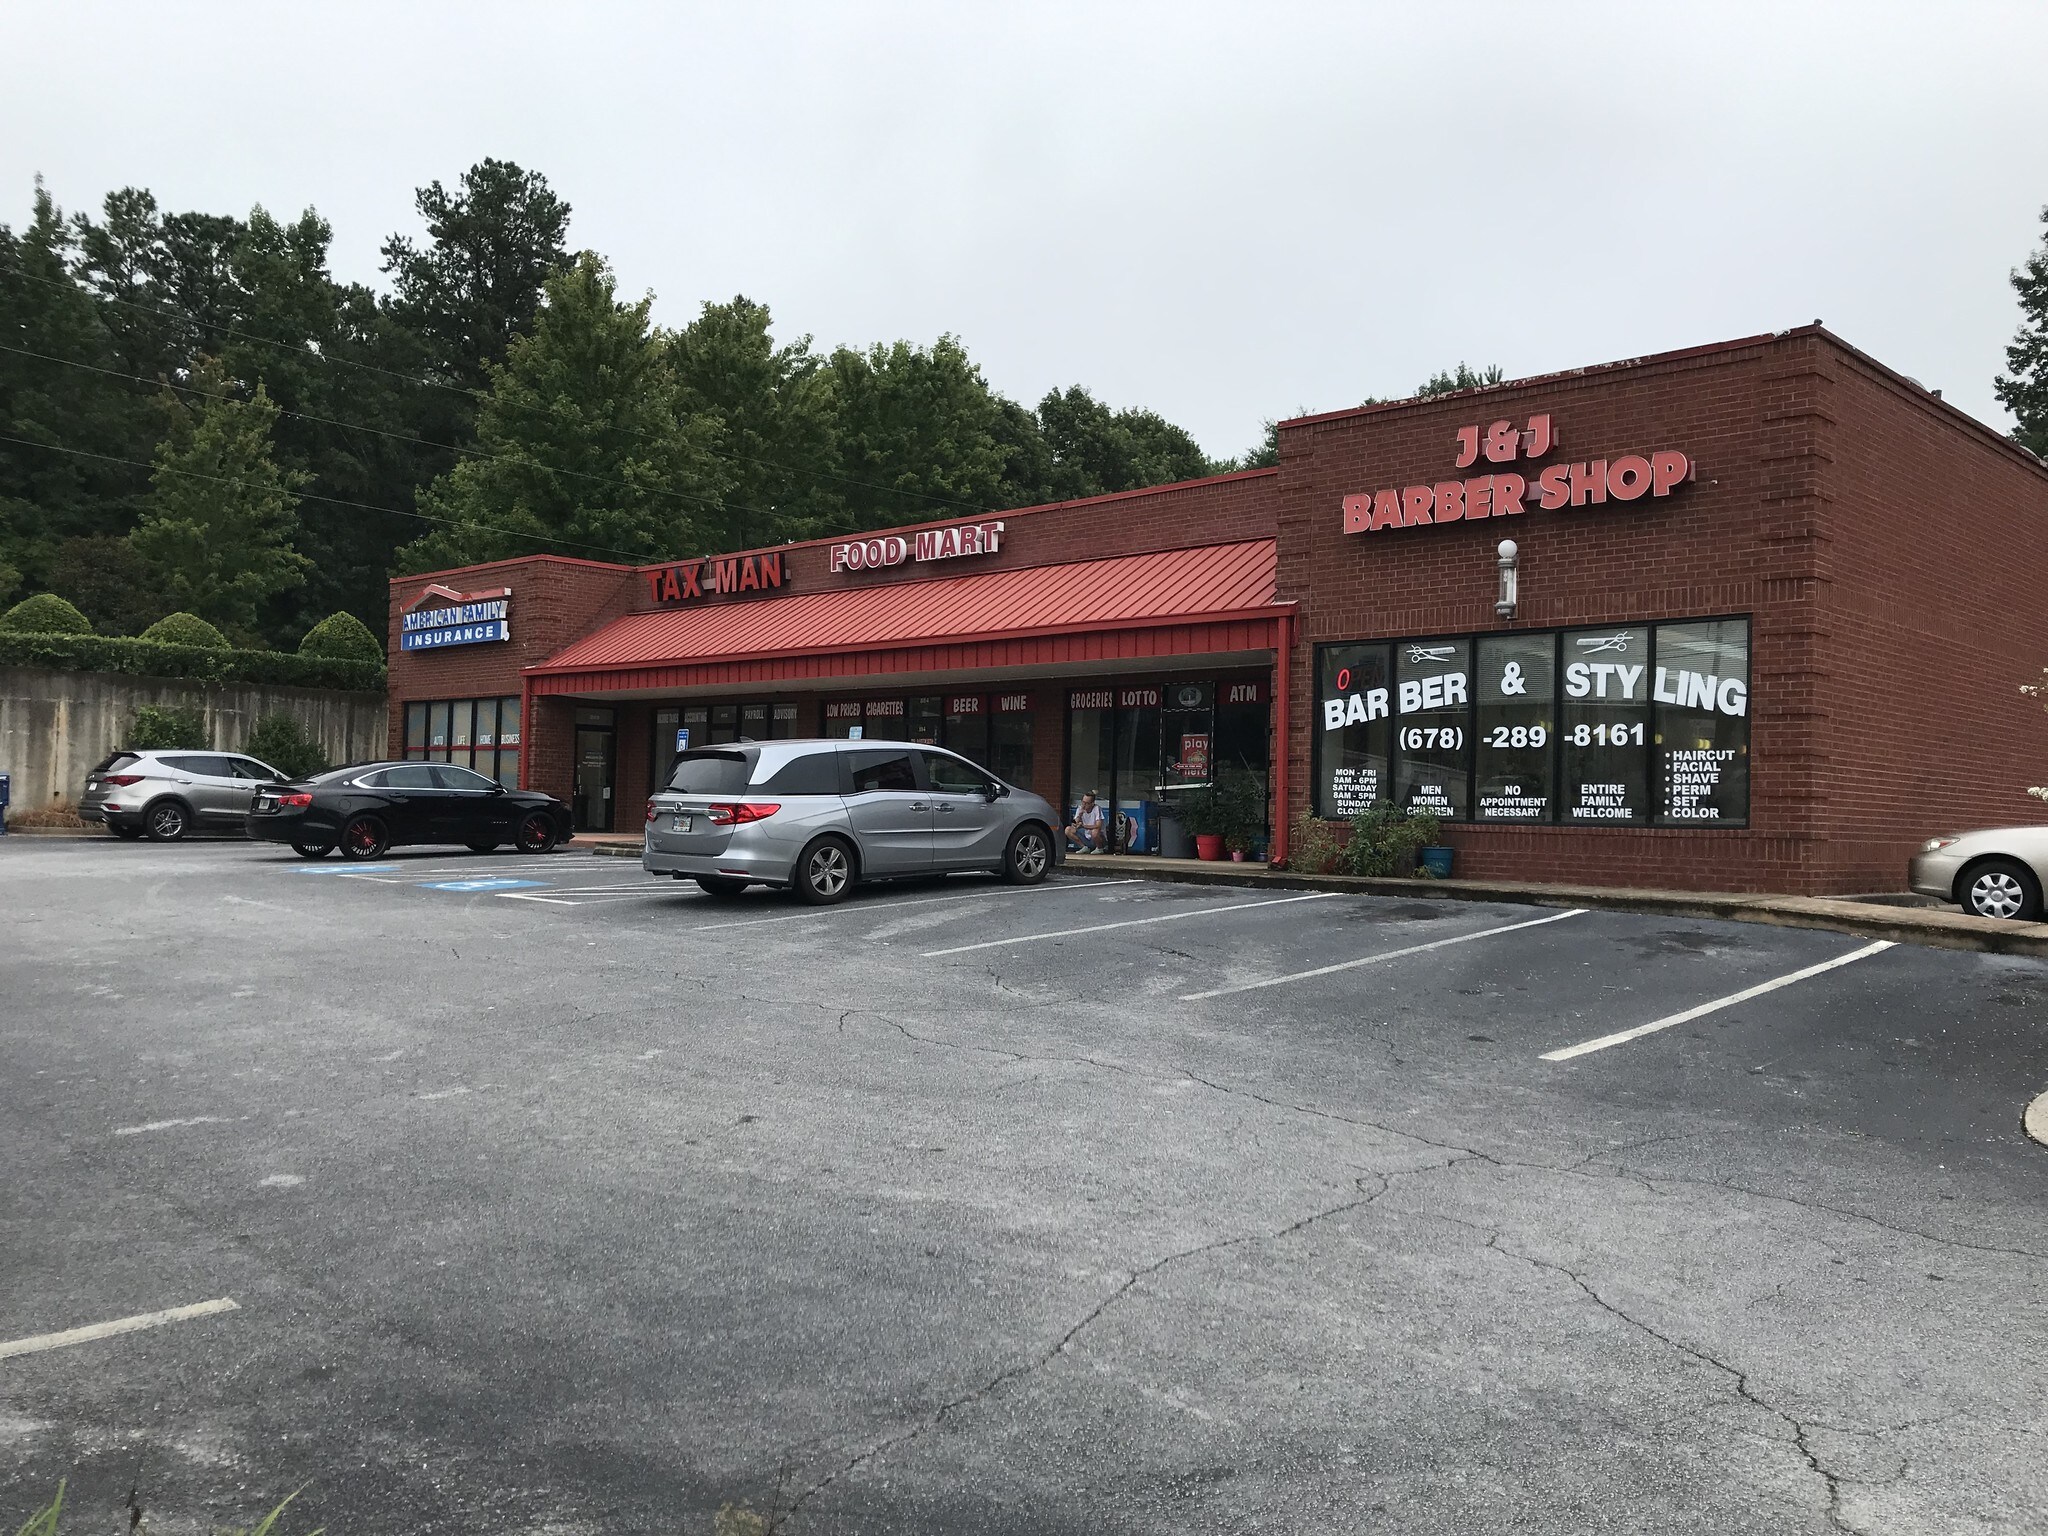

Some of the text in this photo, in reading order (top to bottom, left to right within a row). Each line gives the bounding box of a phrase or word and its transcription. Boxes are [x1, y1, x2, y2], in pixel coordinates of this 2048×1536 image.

[1456, 413, 1550, 468] J&J
[1343, 450, 1689, 534] BARBER SHOP
[830, 521, 1004, 572] FOOD MART
[645, 552, 781, 602] TAX MAN
[403, 600, 504, 631] AMERICAN FAMILY
[409, 625, 494, 646] INSURANCE
[1500, 661, 1526, 695] &
[1122, 690, 1157, 706] LOTTO
[1229, 685, 1257, 702] ATM
[953, 698, 979, 713] BEER
[1001, 695, 1027, 711] WINE
[1070, 691, 1113, 709] GROCERIES
[744, 709, 764, 720] PAYROLL
[773, 708, 798, 720] ADVISORY
[826, 703, 861, 717] LOW PRICED
[866, 701, 904, 716] CIGARETTES
[433, 735, 444, 746] AUTO
[457, 735, 466, 745] LIFE
[480, 734, 492, 745] HOME
[501, 733, 520, 744] BUSINESS
[1400, 723, 1645, 750] (678) -289 -8161
[1184, 738, 1209, 751] play
[1672, 750, 1736, 761] HAIRCUT
[1184, 767, 1208, 776] here
[1335, 768, 1355, 776] MON
[1362, 769, 1377, 777] FRI
[1672, 761, 1722, 773] FACIAL
[1333, 776, 1352, 784] 9AM
[1358, 777, 1377, 785] 6PM
[1672, 773, 1719, 784] SHAVE
[1332, 784, 1377, 792] SATURDAY
[1420, 785, 1442, 795] MEN
[1504, 785, 1522, 796] NO
[1580, 784, 1626, 795] ENTIRE
[1672, 784, 1711, 796] PERM
[1333, 791, 1352, 799] 8AM
[1358, 792, 1377, 800] 5PM
[1412, 796, 1448, 806] WOMEN
[1581, 795, 1625, 807] FAMILY
[1672, 796, 1700, 807] SET
[1336, 800, 1372, 808] SUNDAY
[1479, 797, 1548, 807] APPOINTMENT
[1406, 806, 1454, 817] CHILDREN
[1484, 807, 1541, 817] NECESSARY
[1572, 807, 1633, 819] WELCOME
[1671, 807, 1720, 819] COLOR
